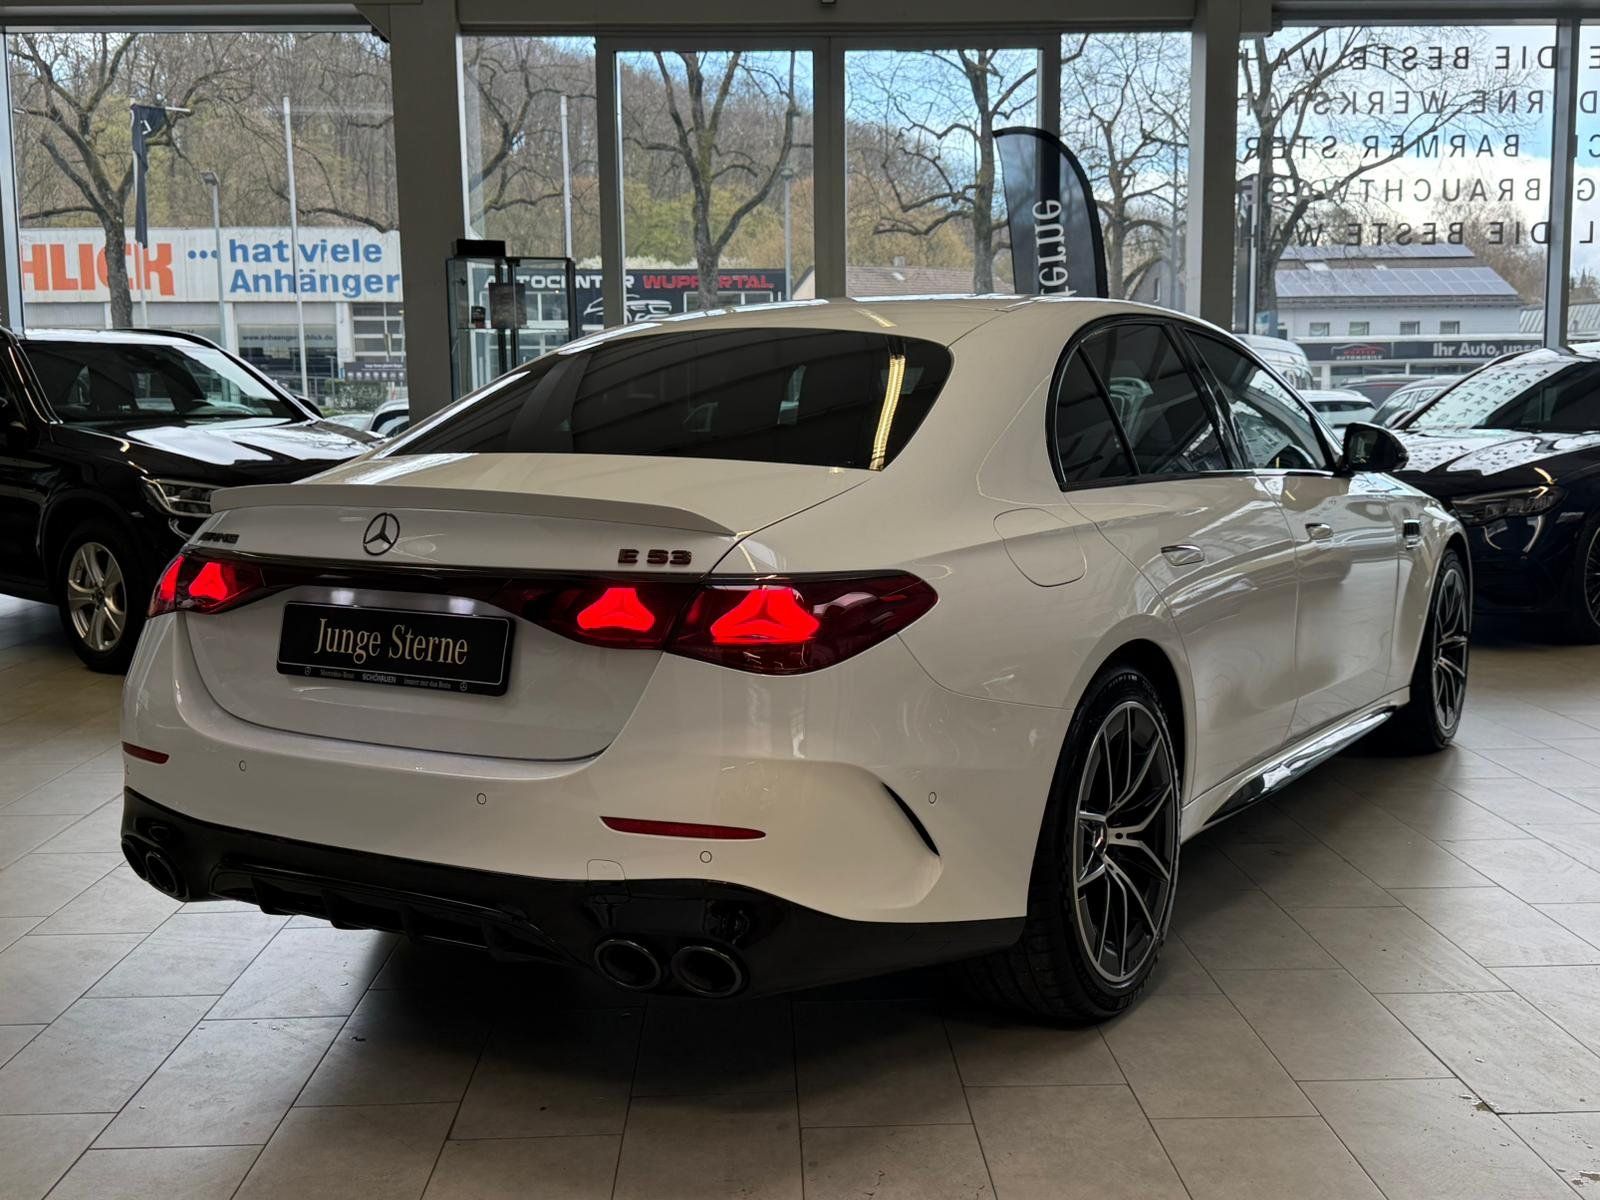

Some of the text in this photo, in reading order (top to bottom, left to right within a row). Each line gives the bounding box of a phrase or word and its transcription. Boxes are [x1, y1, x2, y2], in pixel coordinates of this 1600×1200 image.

[229, 239, 290, 263] hat
[298, 239, 383, 263] viele
[229, 268, 400, 299] Anhänger
[642, 274, 775, 289] WUPPRTAL
[1432, 342, 1456, 357] Ihr
[1458, 342, 1499, 357] Auto,
[617, 548, 692, 566] E 53
[314, 617, 468, 665] Junge Sterne
